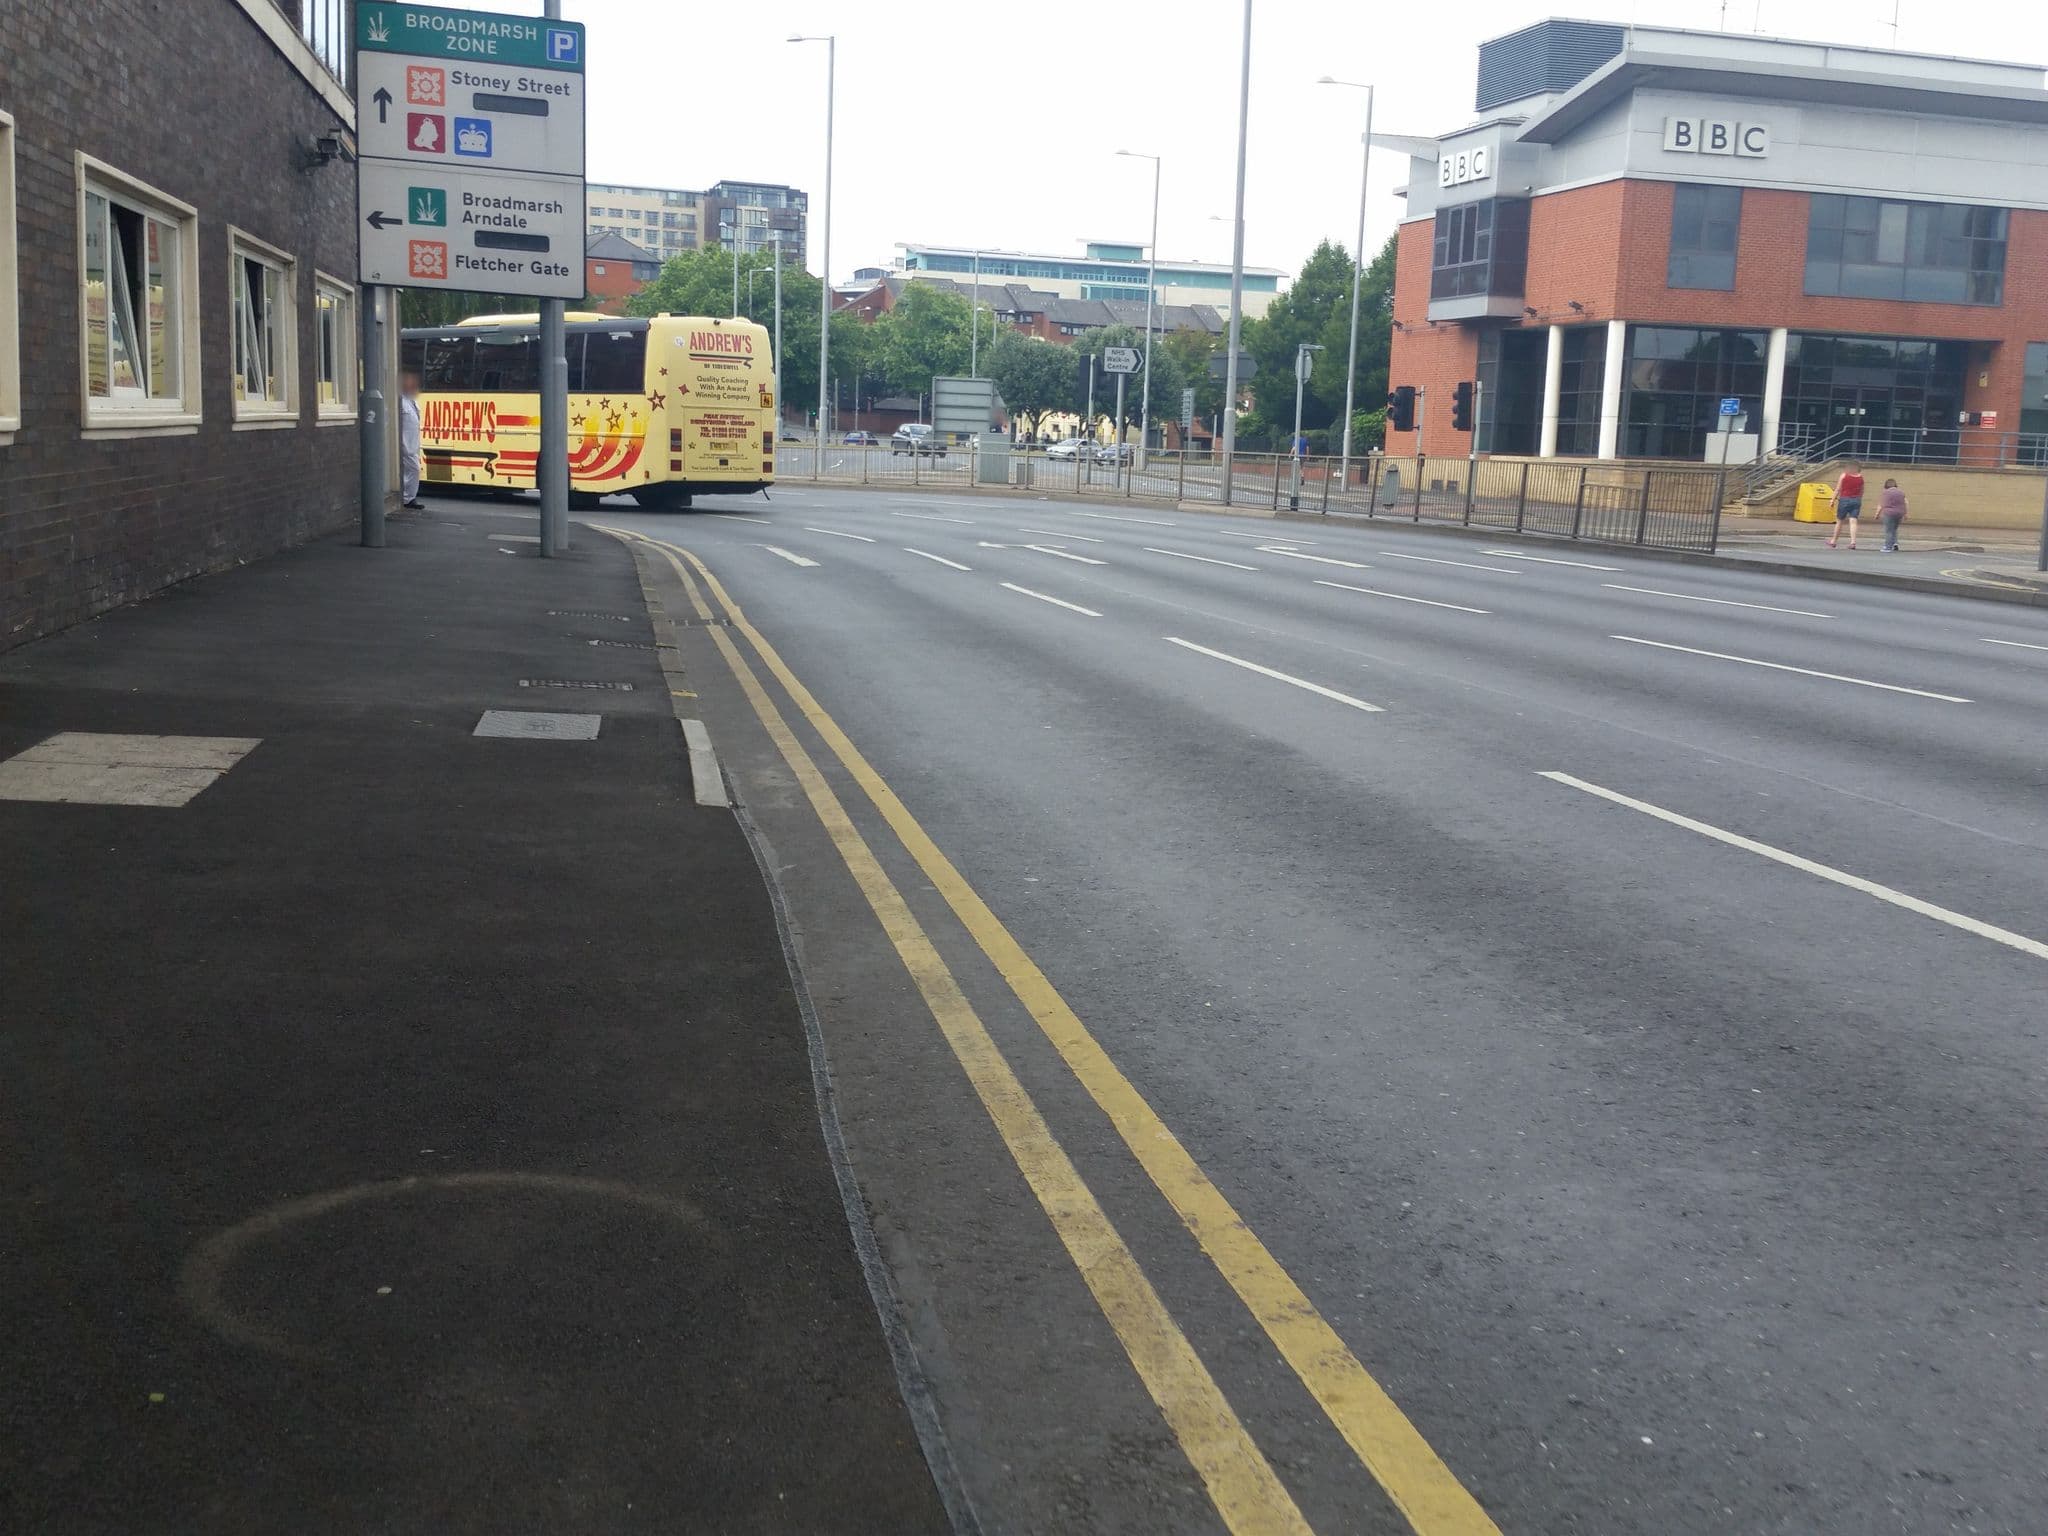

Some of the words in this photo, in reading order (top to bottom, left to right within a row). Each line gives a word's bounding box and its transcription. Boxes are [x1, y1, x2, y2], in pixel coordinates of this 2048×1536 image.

[405, 13, 537, 41] BROADMARSH
[554, 33, 574, 59] P
[446, 35, 498, 55] ZONE
[451, 71, 511, 92] Stoney
[517, 77, 570, 96] Street
[1675, 121, 1766, 153] BBC
[1442, 150, 1485, 183] BBC
[463, 192, 563, 215] Broadmarsh
[462, 210, 528, 229] Arndale
[455, 254, 524, 274] Fletcher
[530, 260, 570, 278] Gate
[689, 331, 753, 354] ANDREW'S
[696, 375, 720, 384] Quality
[721, 376, 749, 386] Coaching
[699, 383, 715, 391] With
[695, 391, 721, 401] Winning
[722, 392, 751, 402] Company
[423, 401, 497, 444] ANDREW'S
